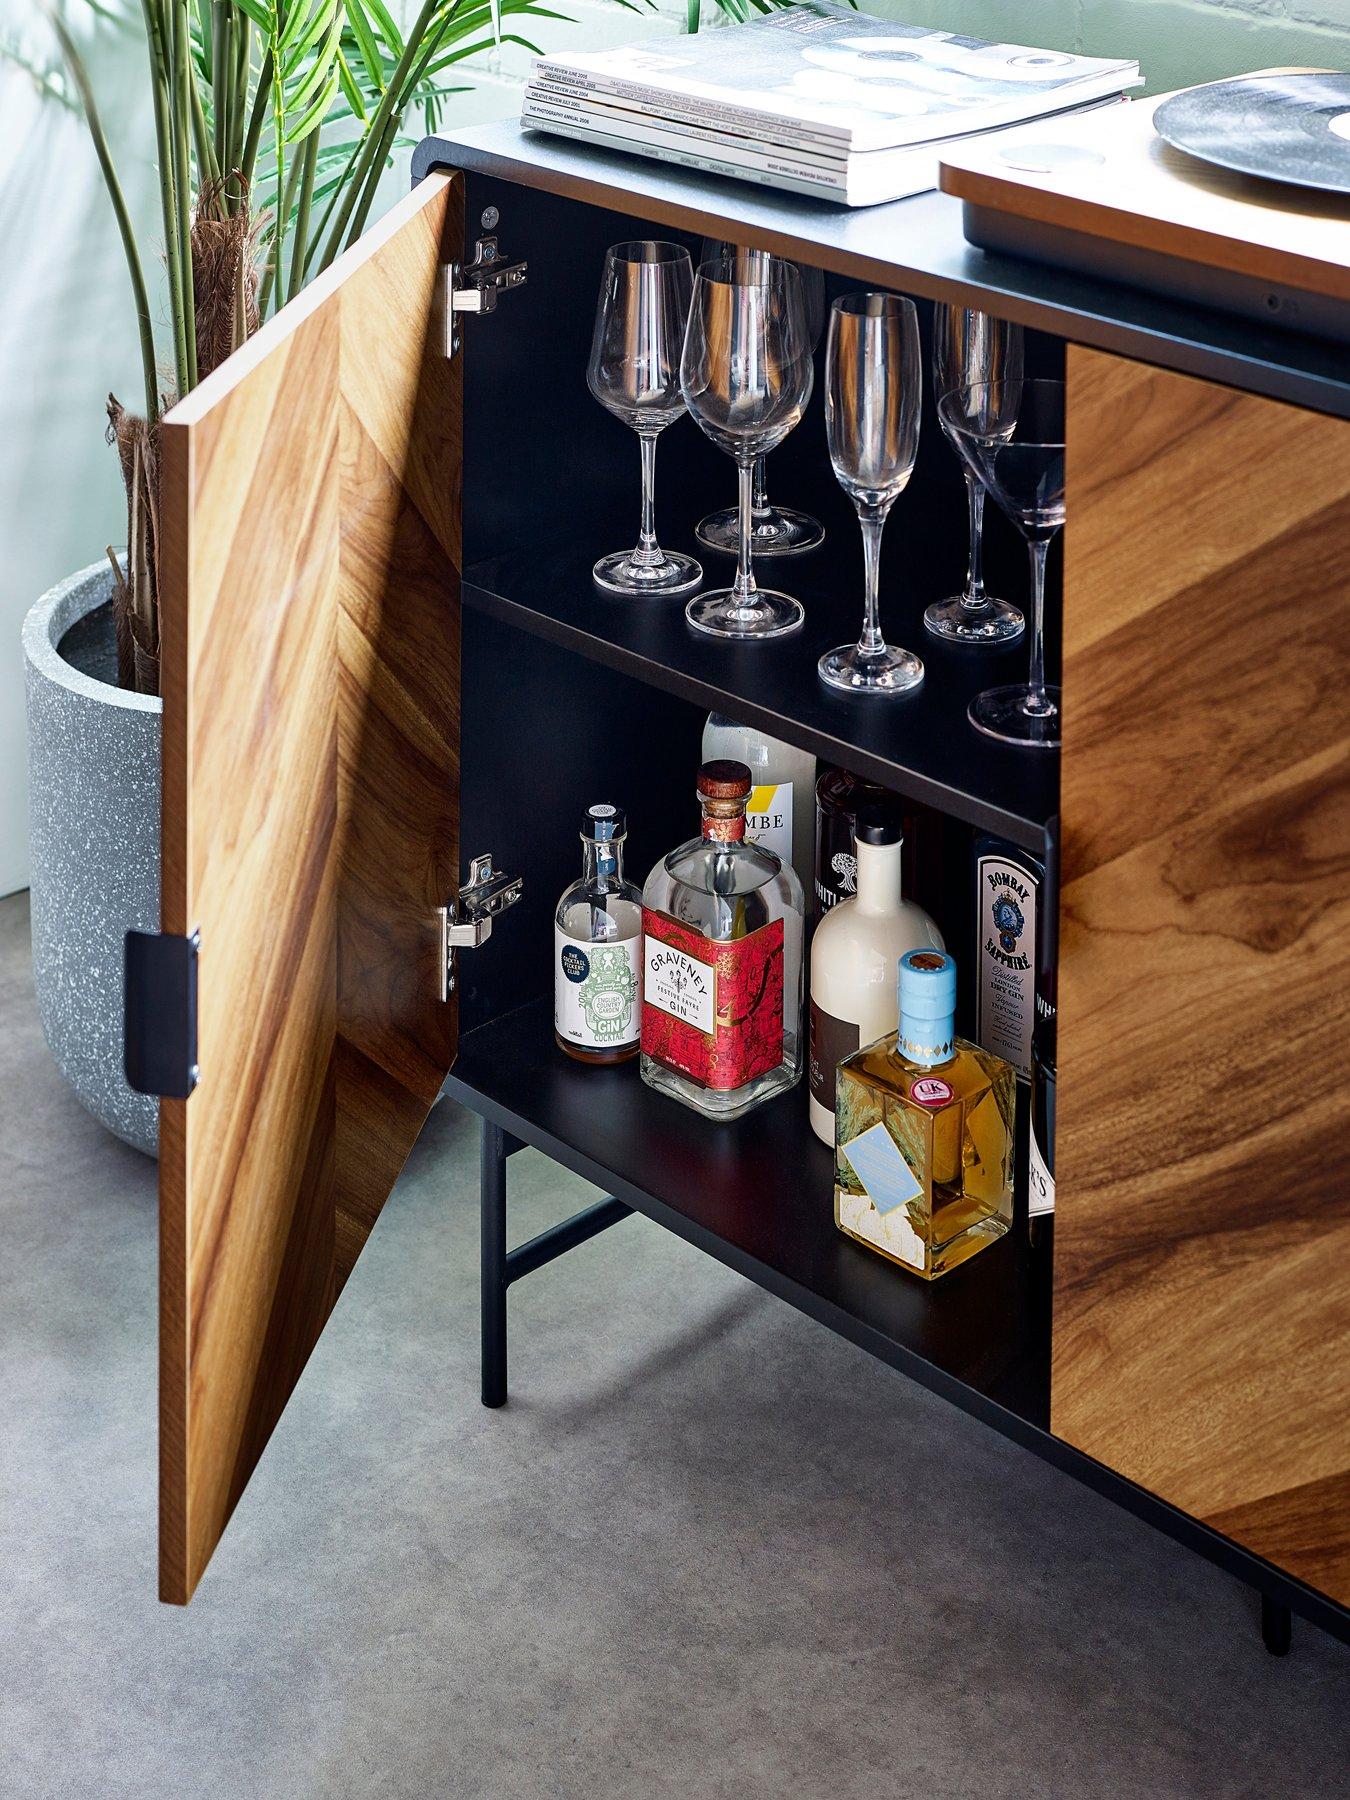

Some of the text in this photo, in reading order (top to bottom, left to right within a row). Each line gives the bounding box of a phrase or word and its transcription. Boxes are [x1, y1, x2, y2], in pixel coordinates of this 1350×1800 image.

[536, 63, 554, 72] CREATIVE
[544, 72, 562, 80] CREATIVE
[562, 76, 576, 84] REVIEW
[555, 85, 569, 93] REVIEW
[531, 92, 549, 100] CREATIVE
[549, 95, 562, 103] REVIEW
[537, 108, 564, 118] PHOTOGRAPHY
[564, 114, 579, 122] ANNUAL
[641, 105, 660, 114] BALLPOINT
[526, 120, 543, 129] CREATIVE
[543, 124, 557, 132] REVIEW
[779, 166, 798, 175] OCTOBER
[800, 170, 816, 179] REVIEW
[816, 174, 837, 184] CREATIVE
[987, 872, 1030, 903] BOMBAY
[984, 938, 1030, 970] SAPPHIRE
[650, 952, 708, 995] GRAVENEY
[992, 966, 1024, 986] Distilled
[994, 978, 1021, 992] LONDON
[991, 982, 1024, 1002] DRY GIN
[658, 986, 680, 1000] FESTIVE
[682, 998, 699, 1011] FAYRE
[670, 1001, 687, 1016] GIN
[992, 1002, 1023, 1020] INFUSED
[1037, 992, 1056, 1018] WH
[594, 1033, 625, 1042] COCKTAIL
[1002, 1040, 1012, 1049] 1761
[919, 1083, 943, 1094] UK
